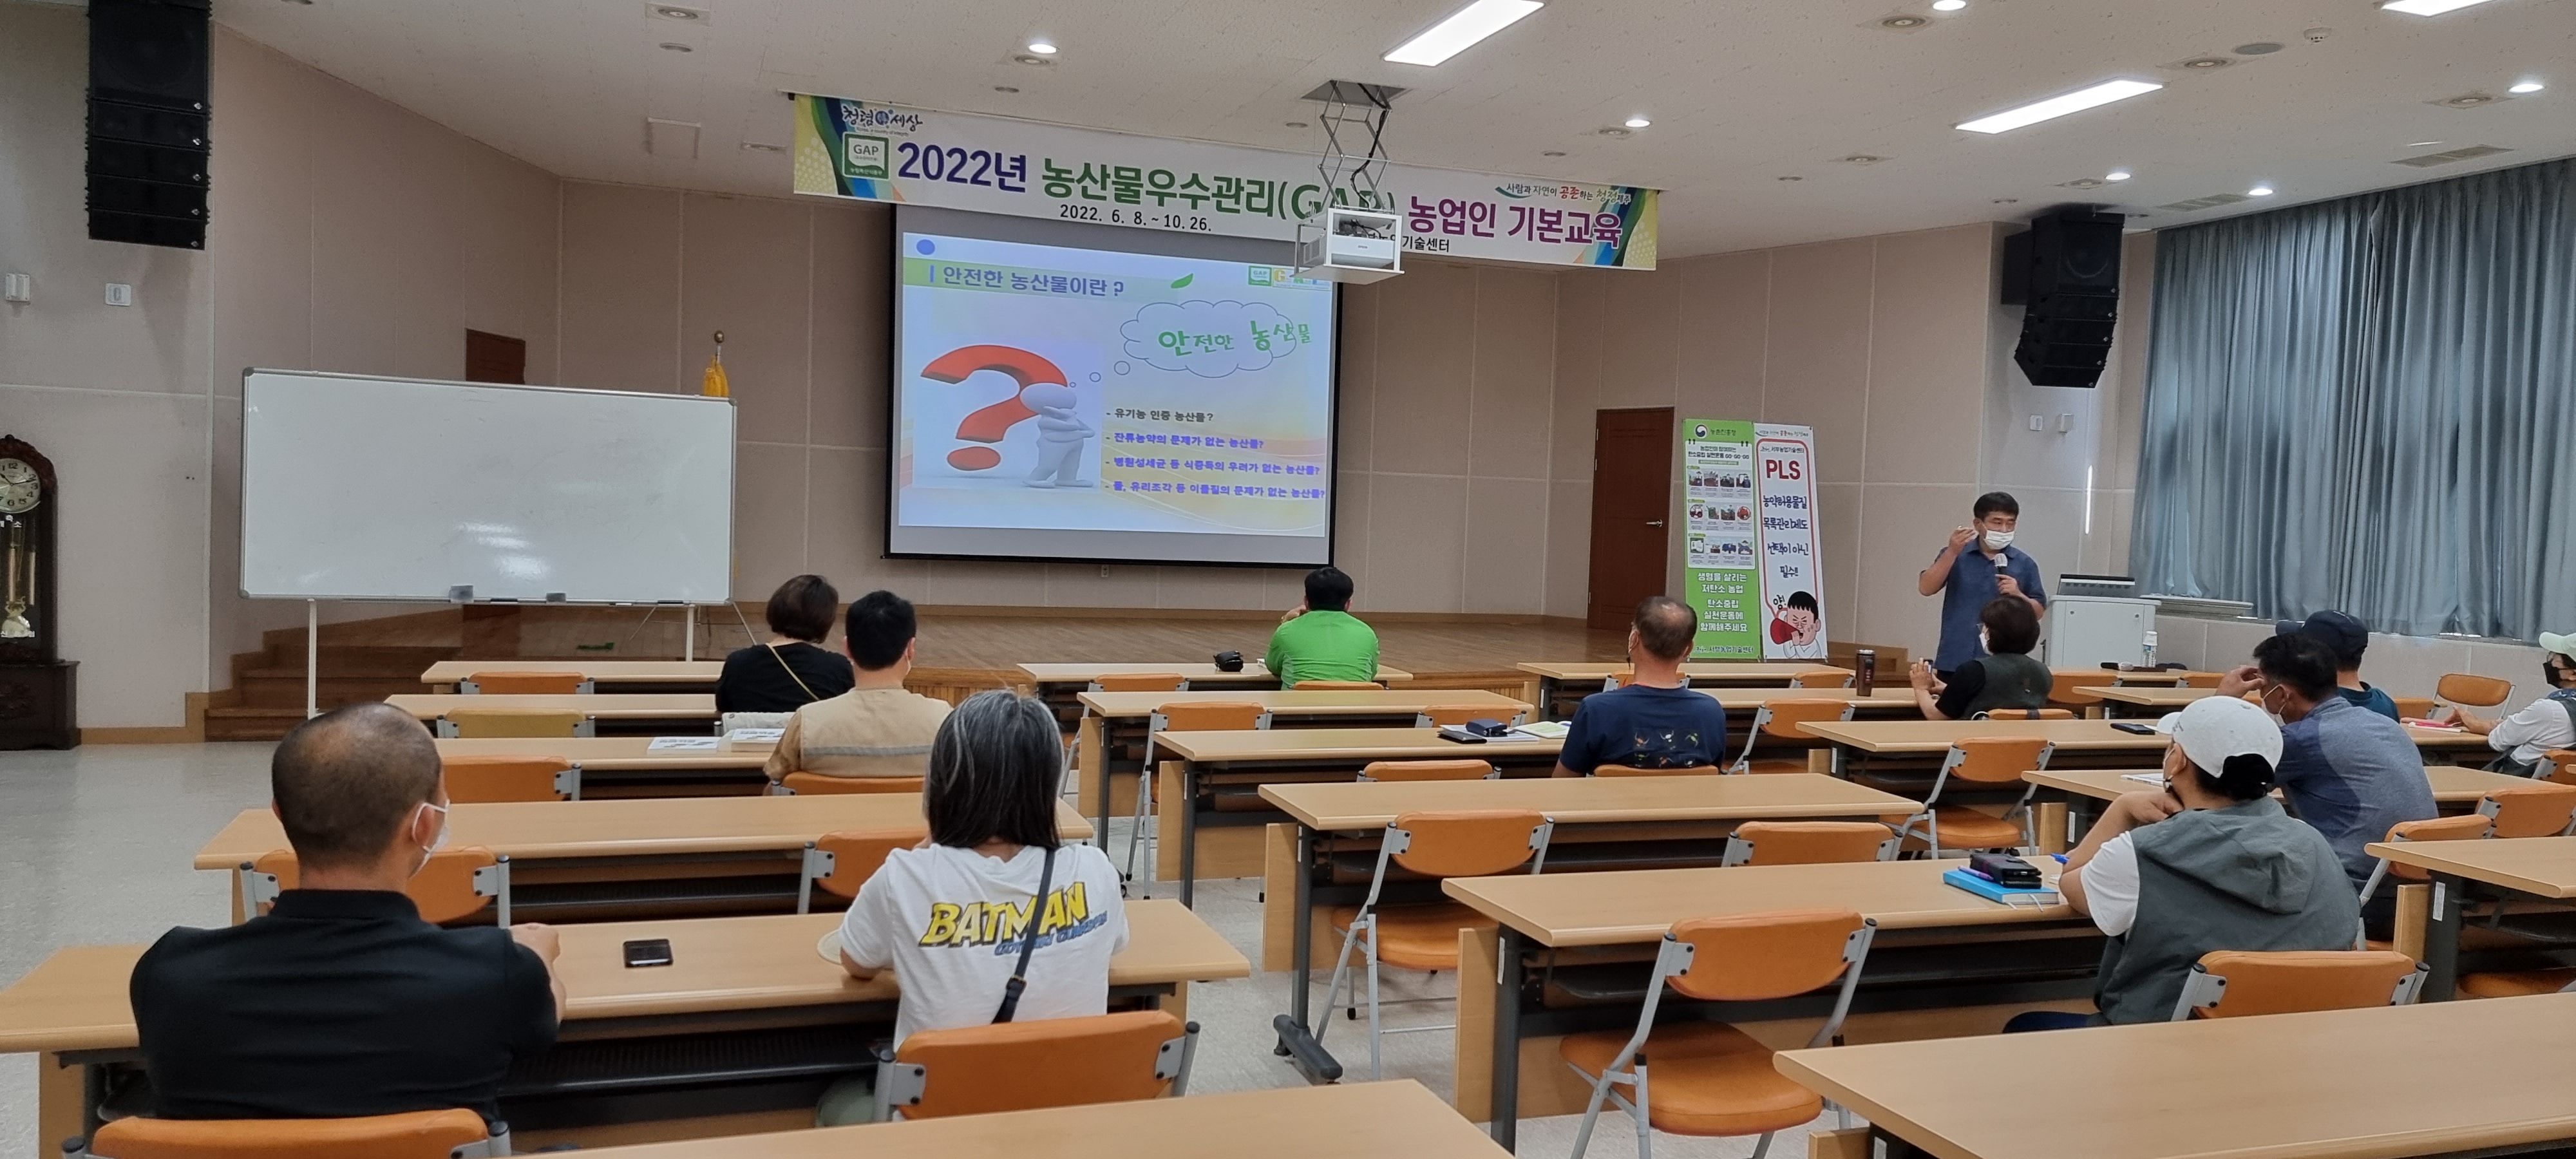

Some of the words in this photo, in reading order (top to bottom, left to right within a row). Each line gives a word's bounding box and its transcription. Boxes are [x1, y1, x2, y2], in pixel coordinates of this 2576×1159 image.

[842, 105, 874, 126] 청렴
[890, 113, 923, 132] 세상
[853, 144, 879, 155] GAP
[897, 142, 1027, 193] 2022년
[1408, 196, 1496, 238] 농업인
[1507, 205, 1622, 249] 기본교육
[1506, 183, 1531, 194] 사람과
[1533, 185, 1557, 197] 자연이
[1559, 186, 1594, 201] 공존하는
[1595, 188, 1632, 204] 청정제주
[1060, 204, 1102, 221] 2022.
[943, 266, 1003, 288] 안전한
[1010, 272, 1107, 297] 농산물이란
[1158, 330, 1235, 356] 안전한
[1249, 320, 1312, 351] 농산물
[1150, 410, 1171, 420] 인증
[1114, 432, 1166, 444] 잔류농약의
[1170, 435, 1202, 446] 문제가
[1205, 437, 1226, 447] 없는
[1228, 462, 1258, 473] 우려가
[1262, 463, 1282, 474] 없는
[1766, 459, 1801, 480] PLS
[1130, 482, 1172, 493] 유리조각
[1234, 485, 1264, 496] 문제가
[1267, 487, 1287, 497] 없는
[1763, 495, 1808, 509] 농약허용물질
[1763, 516, 1808, 531] 목록관리제도
[1767, 541, 1791, 555] 선택이
[1792, 542, 1809, 556] 아닌
[1723, 572, 1747, 582] 살리는
[1701, 584, 1726, 593] 저탄소
[1728, 585, 1743, 594] 농업
[1707, 599, 1739, 608] 탄소중립
[1704, 610, 1743, 620] 실천운동에
[1700, 622, 1748, 632] 함께해주세요
[918, 881, 1090, 948] BATMAN
